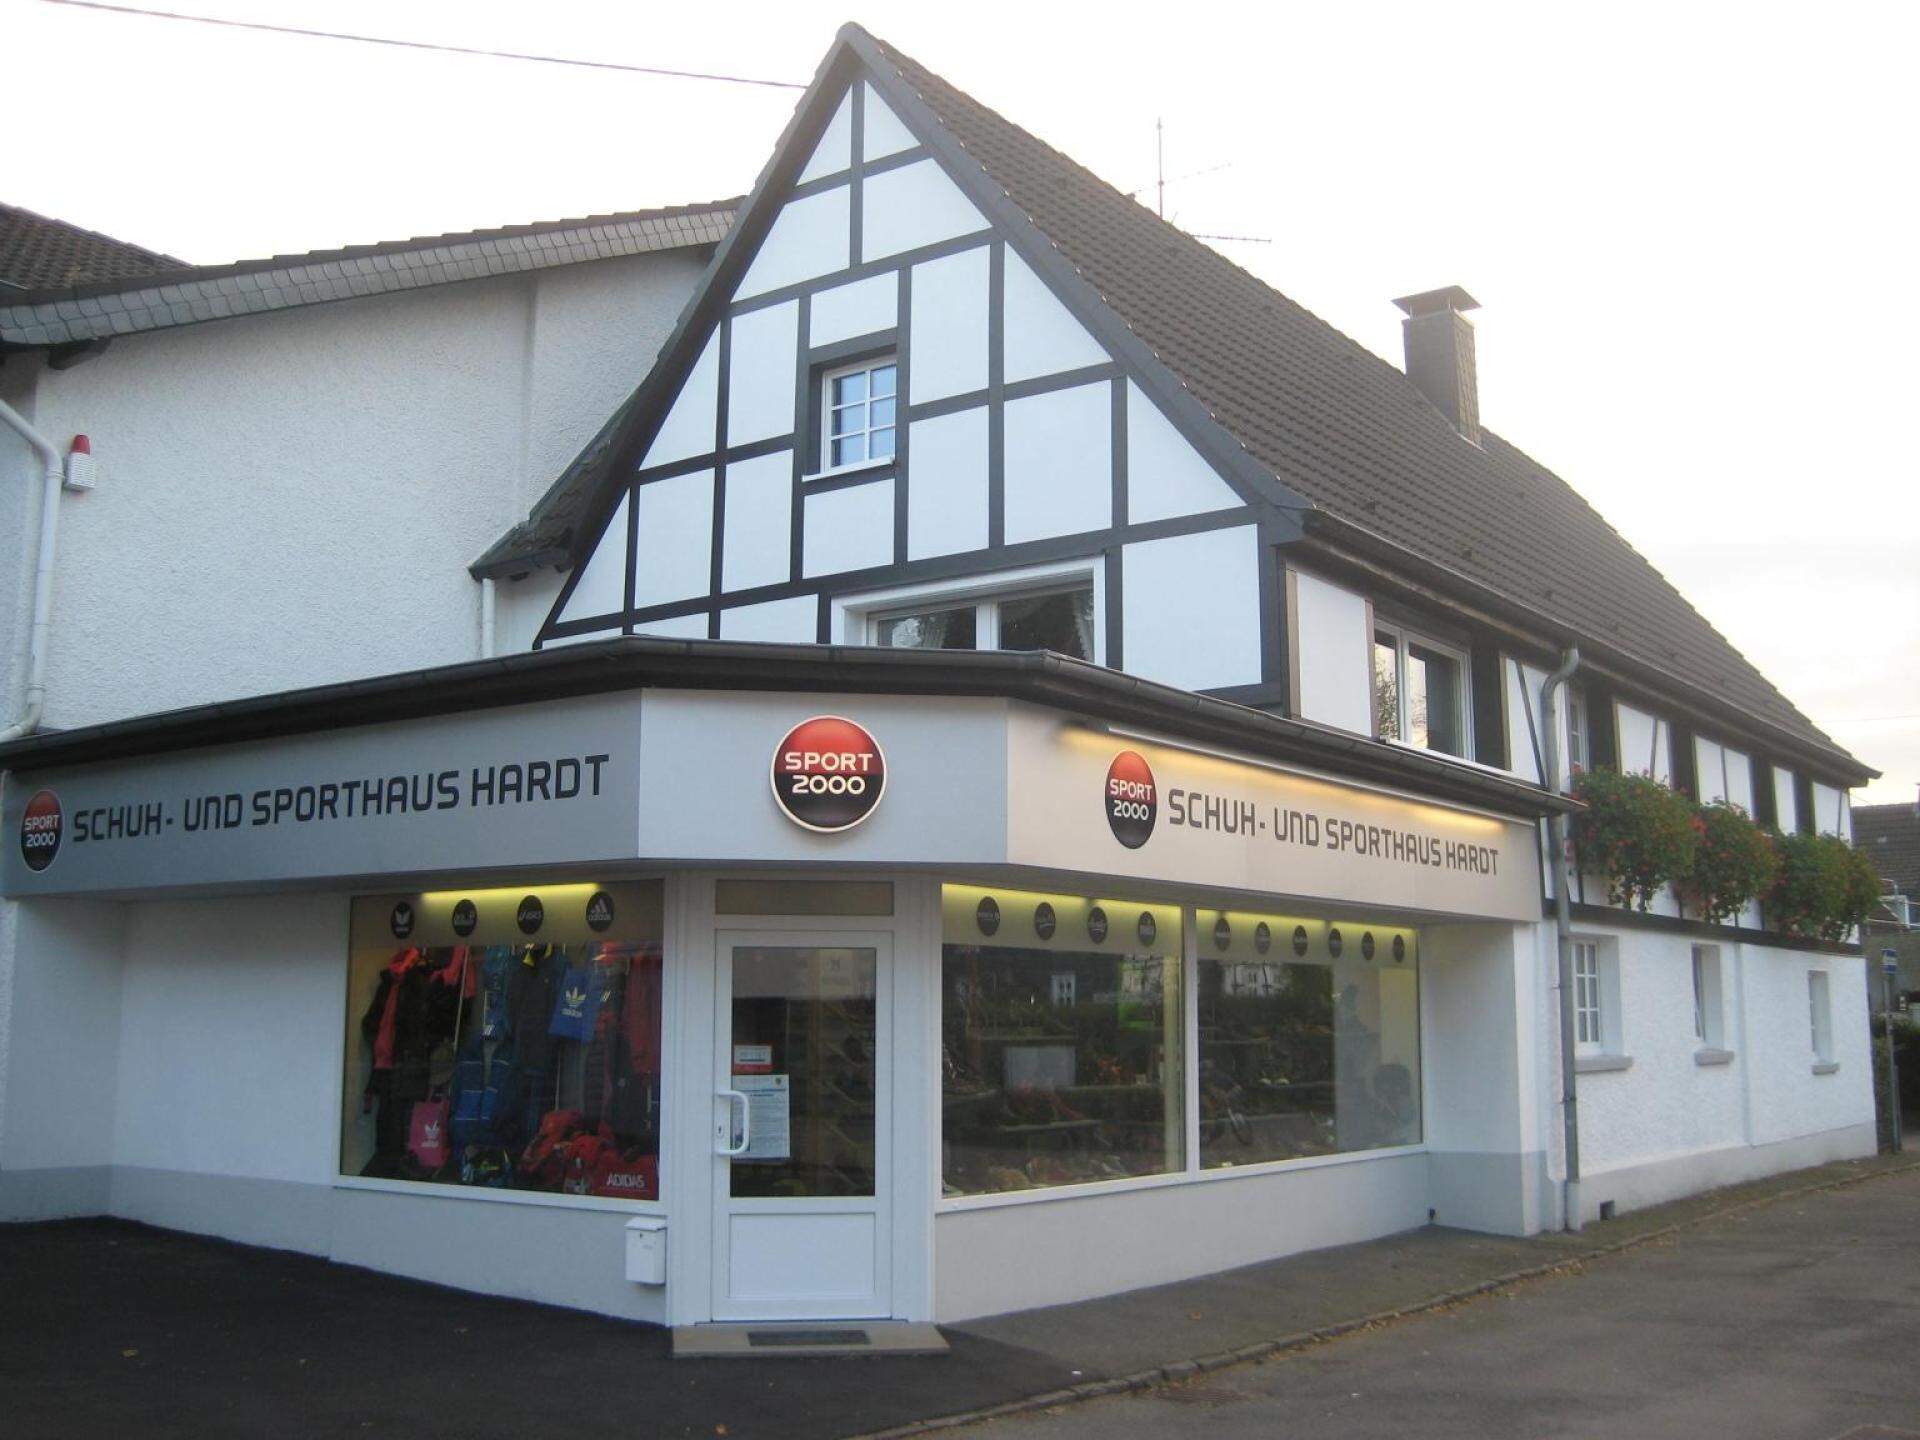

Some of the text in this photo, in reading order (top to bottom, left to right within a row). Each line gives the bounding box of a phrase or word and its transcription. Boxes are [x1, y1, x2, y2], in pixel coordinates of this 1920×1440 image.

[784, 752, 873, 771] SPORT
[792, 774, 866, 795] 2000
[1109, 778, 1153, 801] SPORT
[73, 754, 610, 842] SCHUH- UND SPORTHAUS HARDT
[1113, 800, 1150, 821] 2000
[24, 814, 60, 831] SPORT
[1168, 788, 1499, 876] SCHUH- UND SPORTHAUS HARDT
[26, 831, 56, 848] 2000
[606, 1172, 646, 1189] ADIDAS
